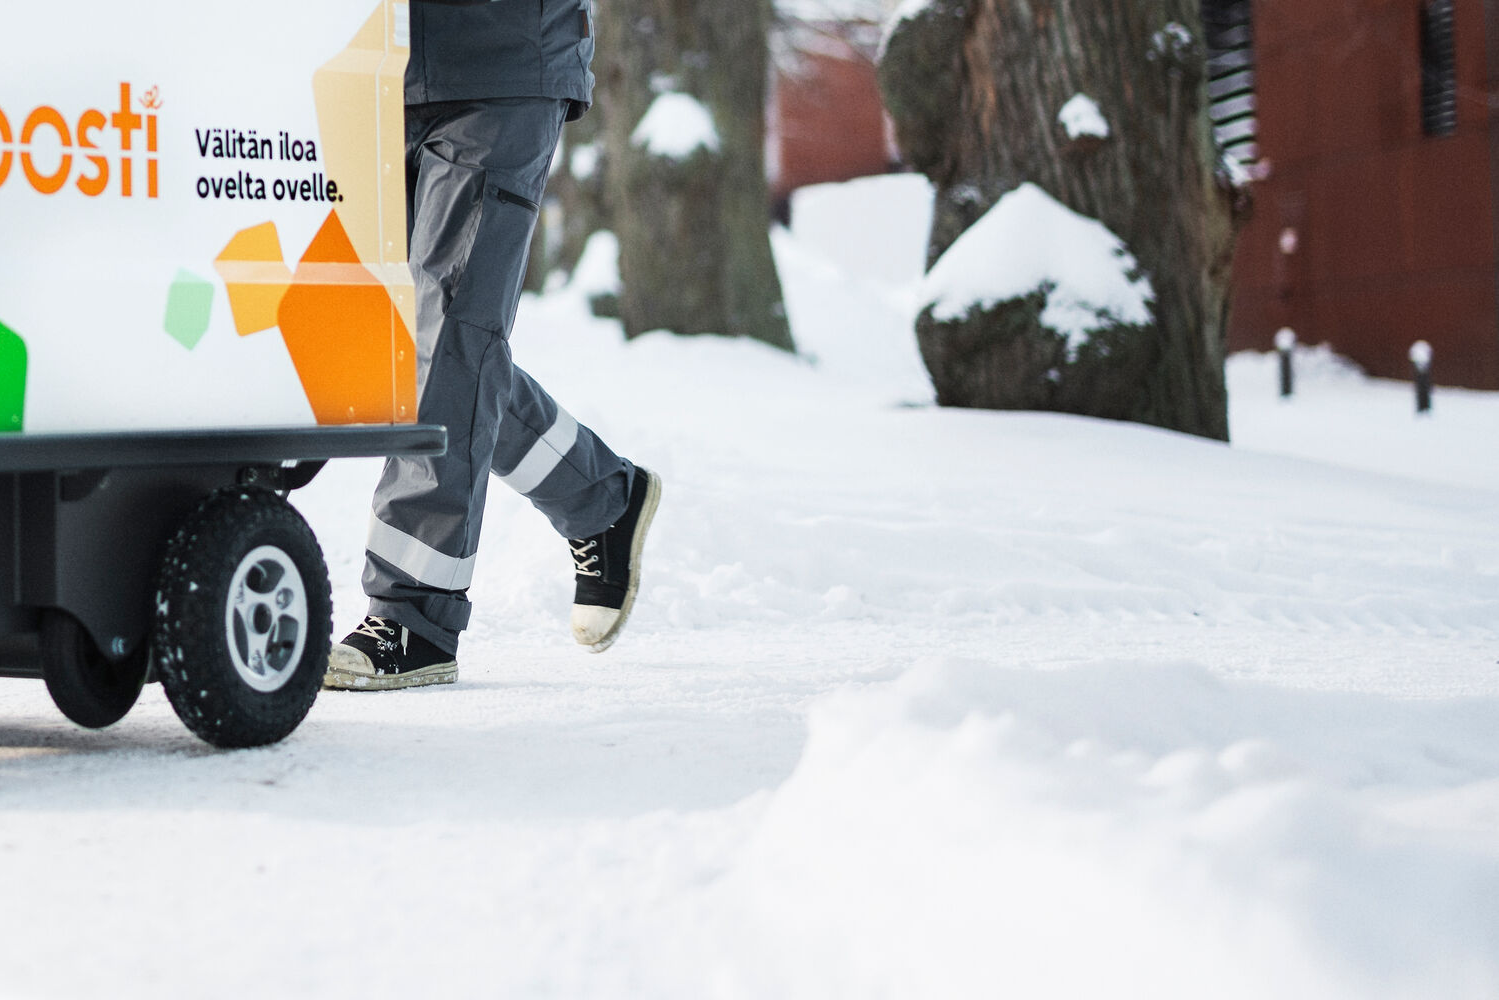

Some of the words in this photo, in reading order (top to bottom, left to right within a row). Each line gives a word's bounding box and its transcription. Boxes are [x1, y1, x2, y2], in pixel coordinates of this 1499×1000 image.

[194, 129, 274, 160] Välitän
[278, 131, 318, 162] iloa
[195, 170, 268, 200] ovelta
[271, 172, 345, 203] ovelle.
